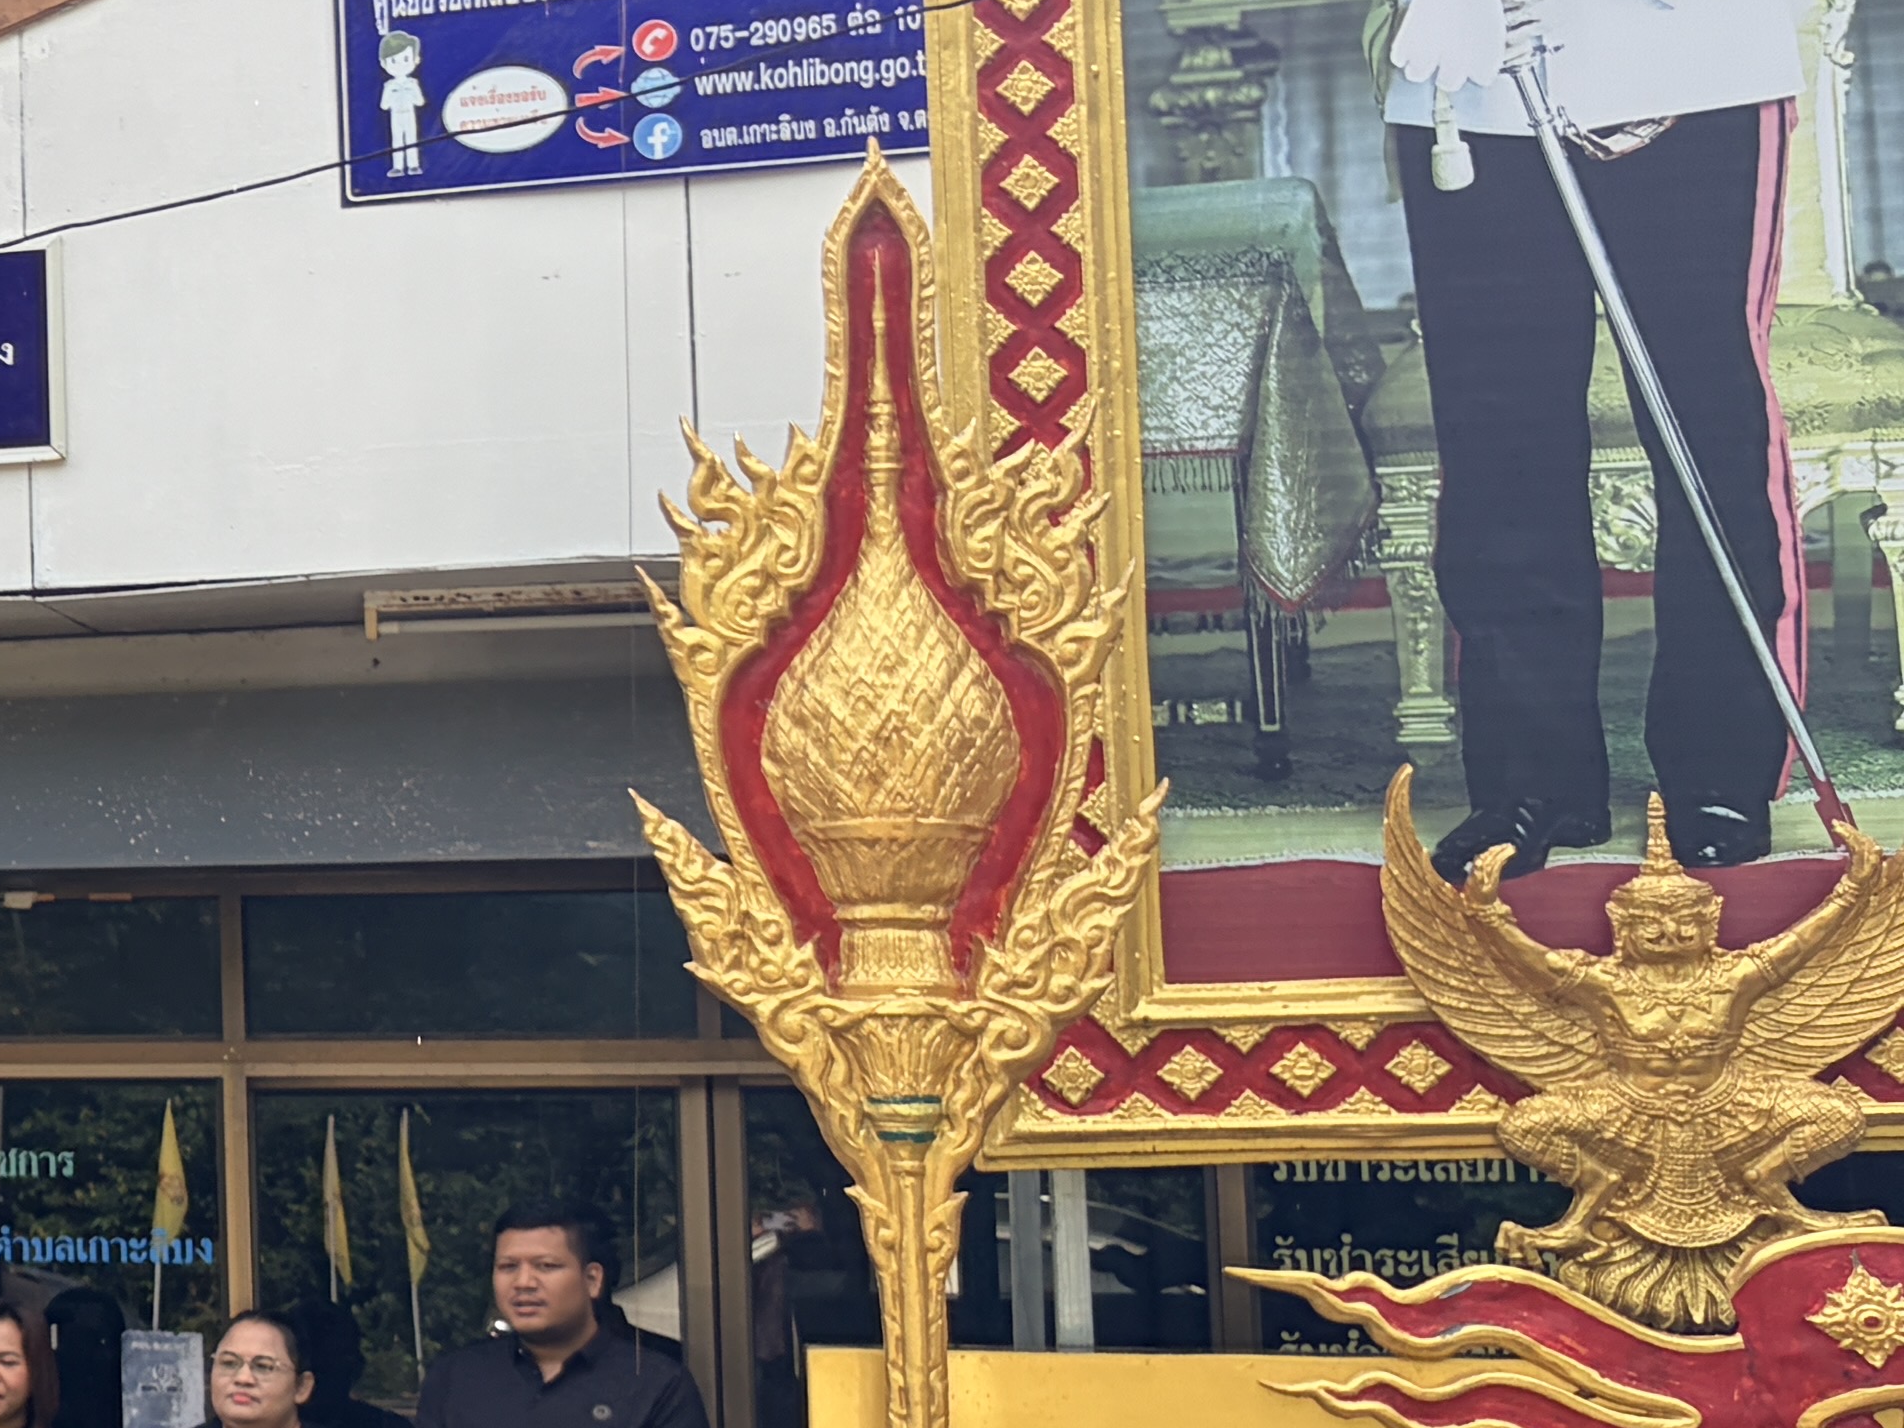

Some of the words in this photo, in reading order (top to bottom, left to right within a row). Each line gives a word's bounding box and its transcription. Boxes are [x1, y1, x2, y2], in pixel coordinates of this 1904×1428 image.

[690, 13, 837, 52] 075-290965
[700, 113, 817, 149] อบต.เกาะลิบง
[823, 105, 890, 139] อ.กันตัง
